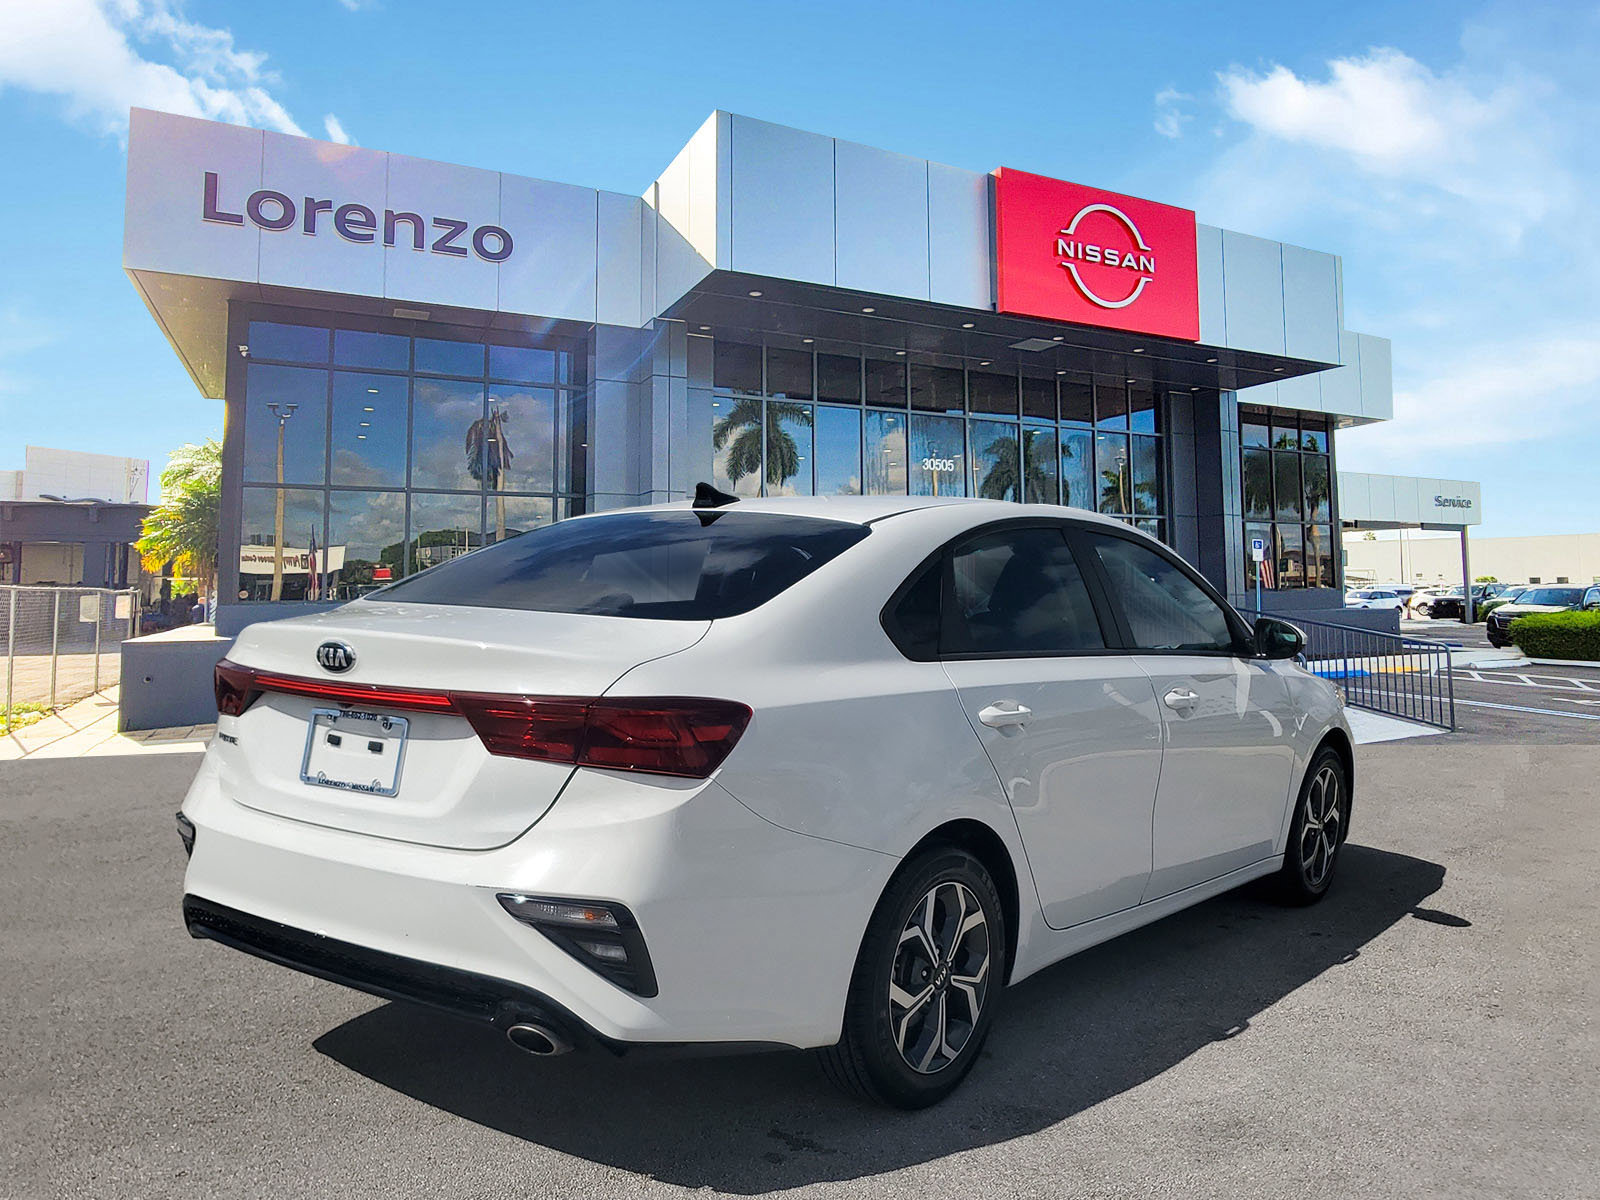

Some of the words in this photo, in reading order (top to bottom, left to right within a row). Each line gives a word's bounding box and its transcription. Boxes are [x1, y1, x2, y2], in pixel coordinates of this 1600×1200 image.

[203, 171, 514, 262] Lorenzo
[1057, 238, 1155, 273] NISSAN
[922, 457, 955, 472] 30505
[1434, 495, 1472, 509] Service
[319, 646, 348, 667] KIA
[318, 778, 346, 788] LORENZO
[351, 784, 375, 793] NISSAN
